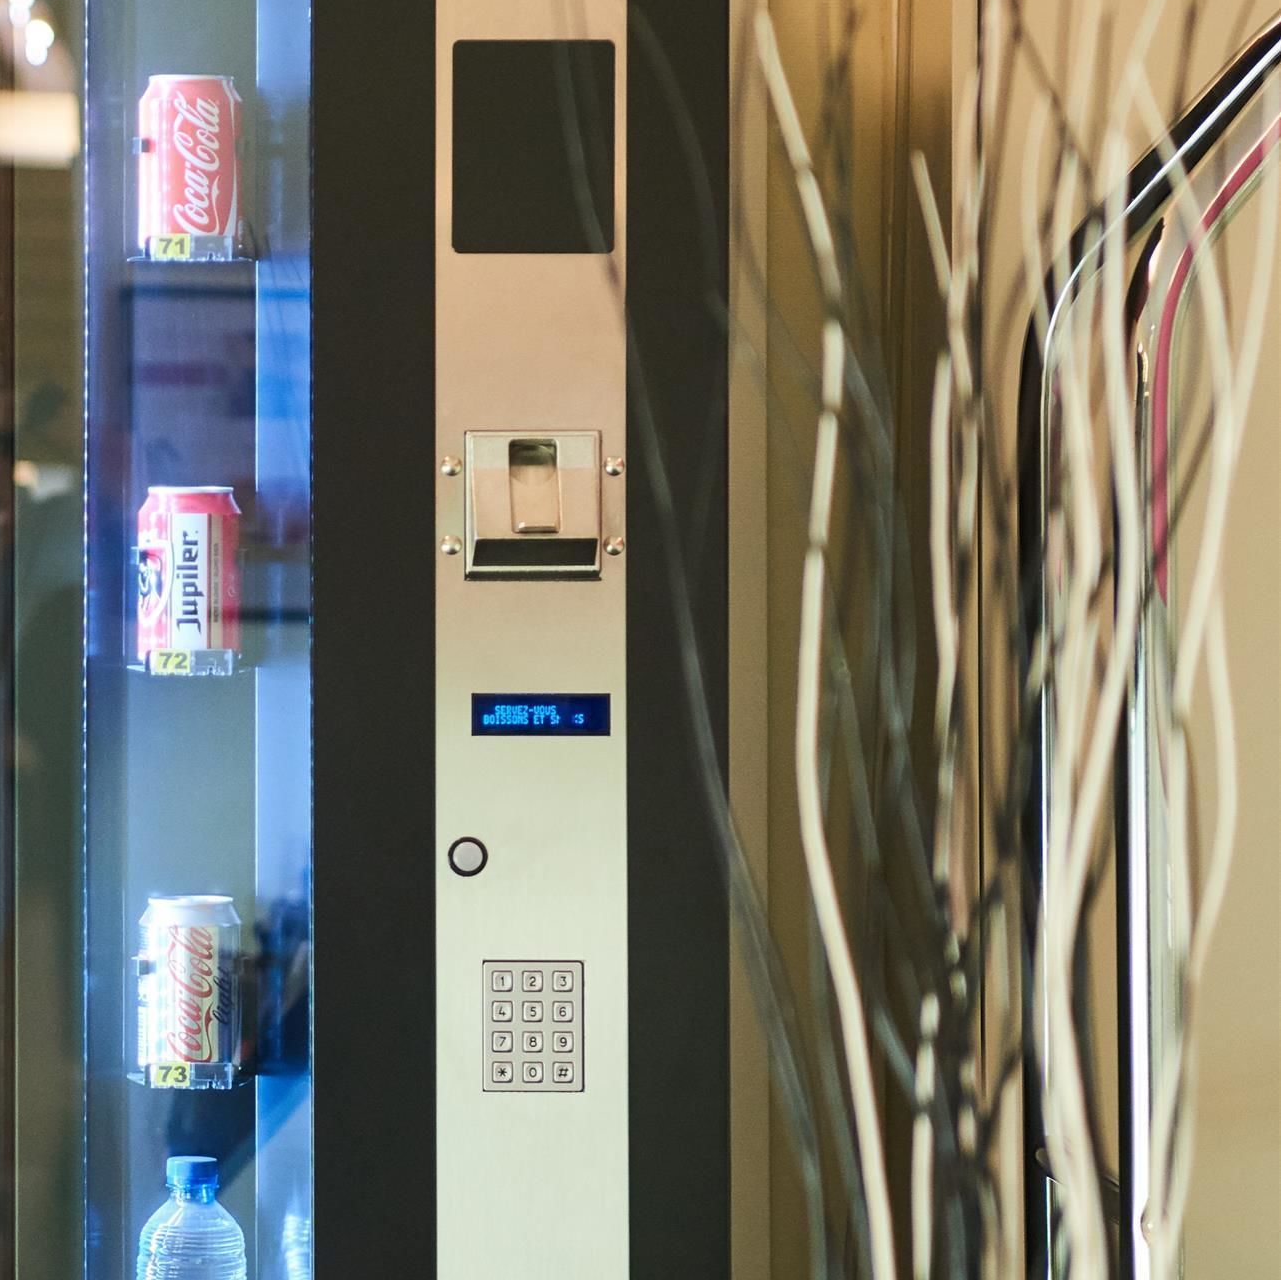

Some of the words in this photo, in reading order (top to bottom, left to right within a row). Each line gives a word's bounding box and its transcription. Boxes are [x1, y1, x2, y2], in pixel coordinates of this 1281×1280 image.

[173, 90, 221, 236] Coca-Cola
[158, 237, 187, 255] 71
[176, 531, 205, 635] Jupiler
[158, 652, 188, 670] 72
[494, 705, 557, 715] SERVEZ-VOUS
[483, 714, 529, 725] BOISSONS
[533, 714, 545, 725] ET
[528, 976, 537, 987] 2
[559, 976, 567, 987] 3
[166, 922, 214, 1063] Coca-Cola
[498, 1006, 507, 1018] 4
[529, 1006, 537, 1018] 5
[558, 1006, 567, 1018] 6
[498, 1036, 507, 1048] 7
[528, 1036, 537, 1048] 8
[559, 1036, 567, 1048] 9
[158, 1065, 188, 1083] 73
[528, 1067, 537, 1078] 0
